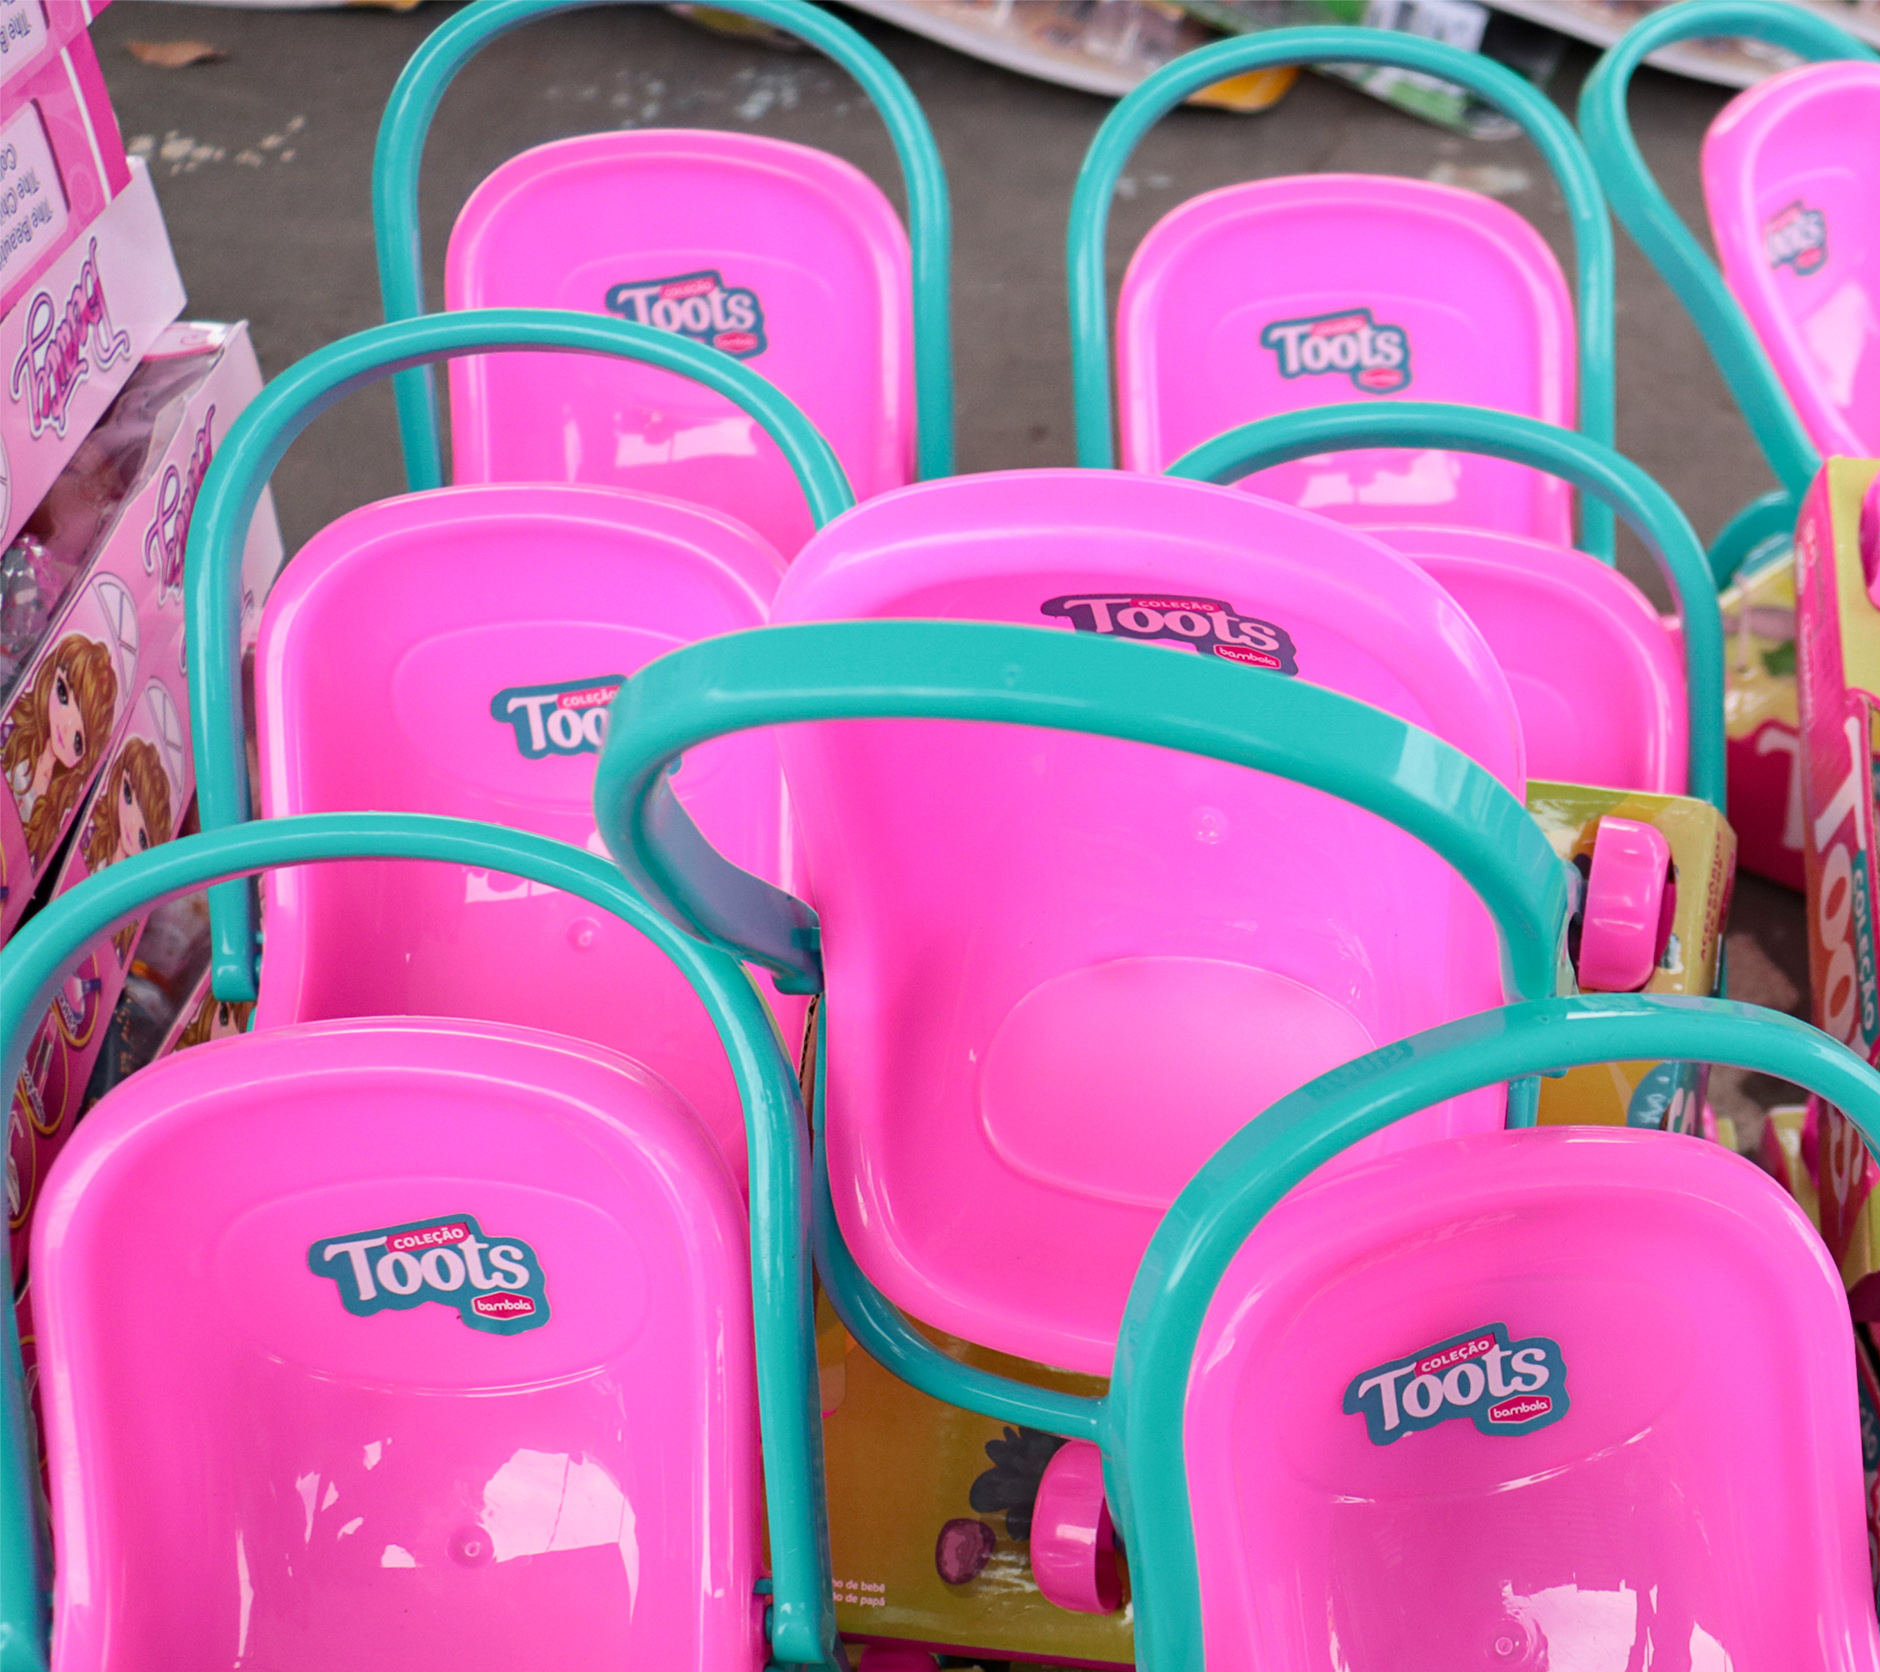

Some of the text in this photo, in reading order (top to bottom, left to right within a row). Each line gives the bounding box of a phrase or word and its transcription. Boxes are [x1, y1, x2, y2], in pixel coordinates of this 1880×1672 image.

[617, 285, 757, 333] Toots
[10, 235, 131, 438] Beauty
[1268, 324, 1403, 375] Toots
[1063, 597, 1280, 652] Toots
[1138, 600, 1215, 612] COLEÇÃO
[1219, 647, 1278, 668] bambola
[393, 1226, 465, 1250] COLEÇÃO
[323, 1234, 530, 1301] Toots
[477, 1300, 533, 1312] bambola
[1421, 1340, 1490, 1373] COLEÇÃO
[1357, 1343, 1550, 1431] Toots
[1493, 1400, 1549, 1419] bambola
